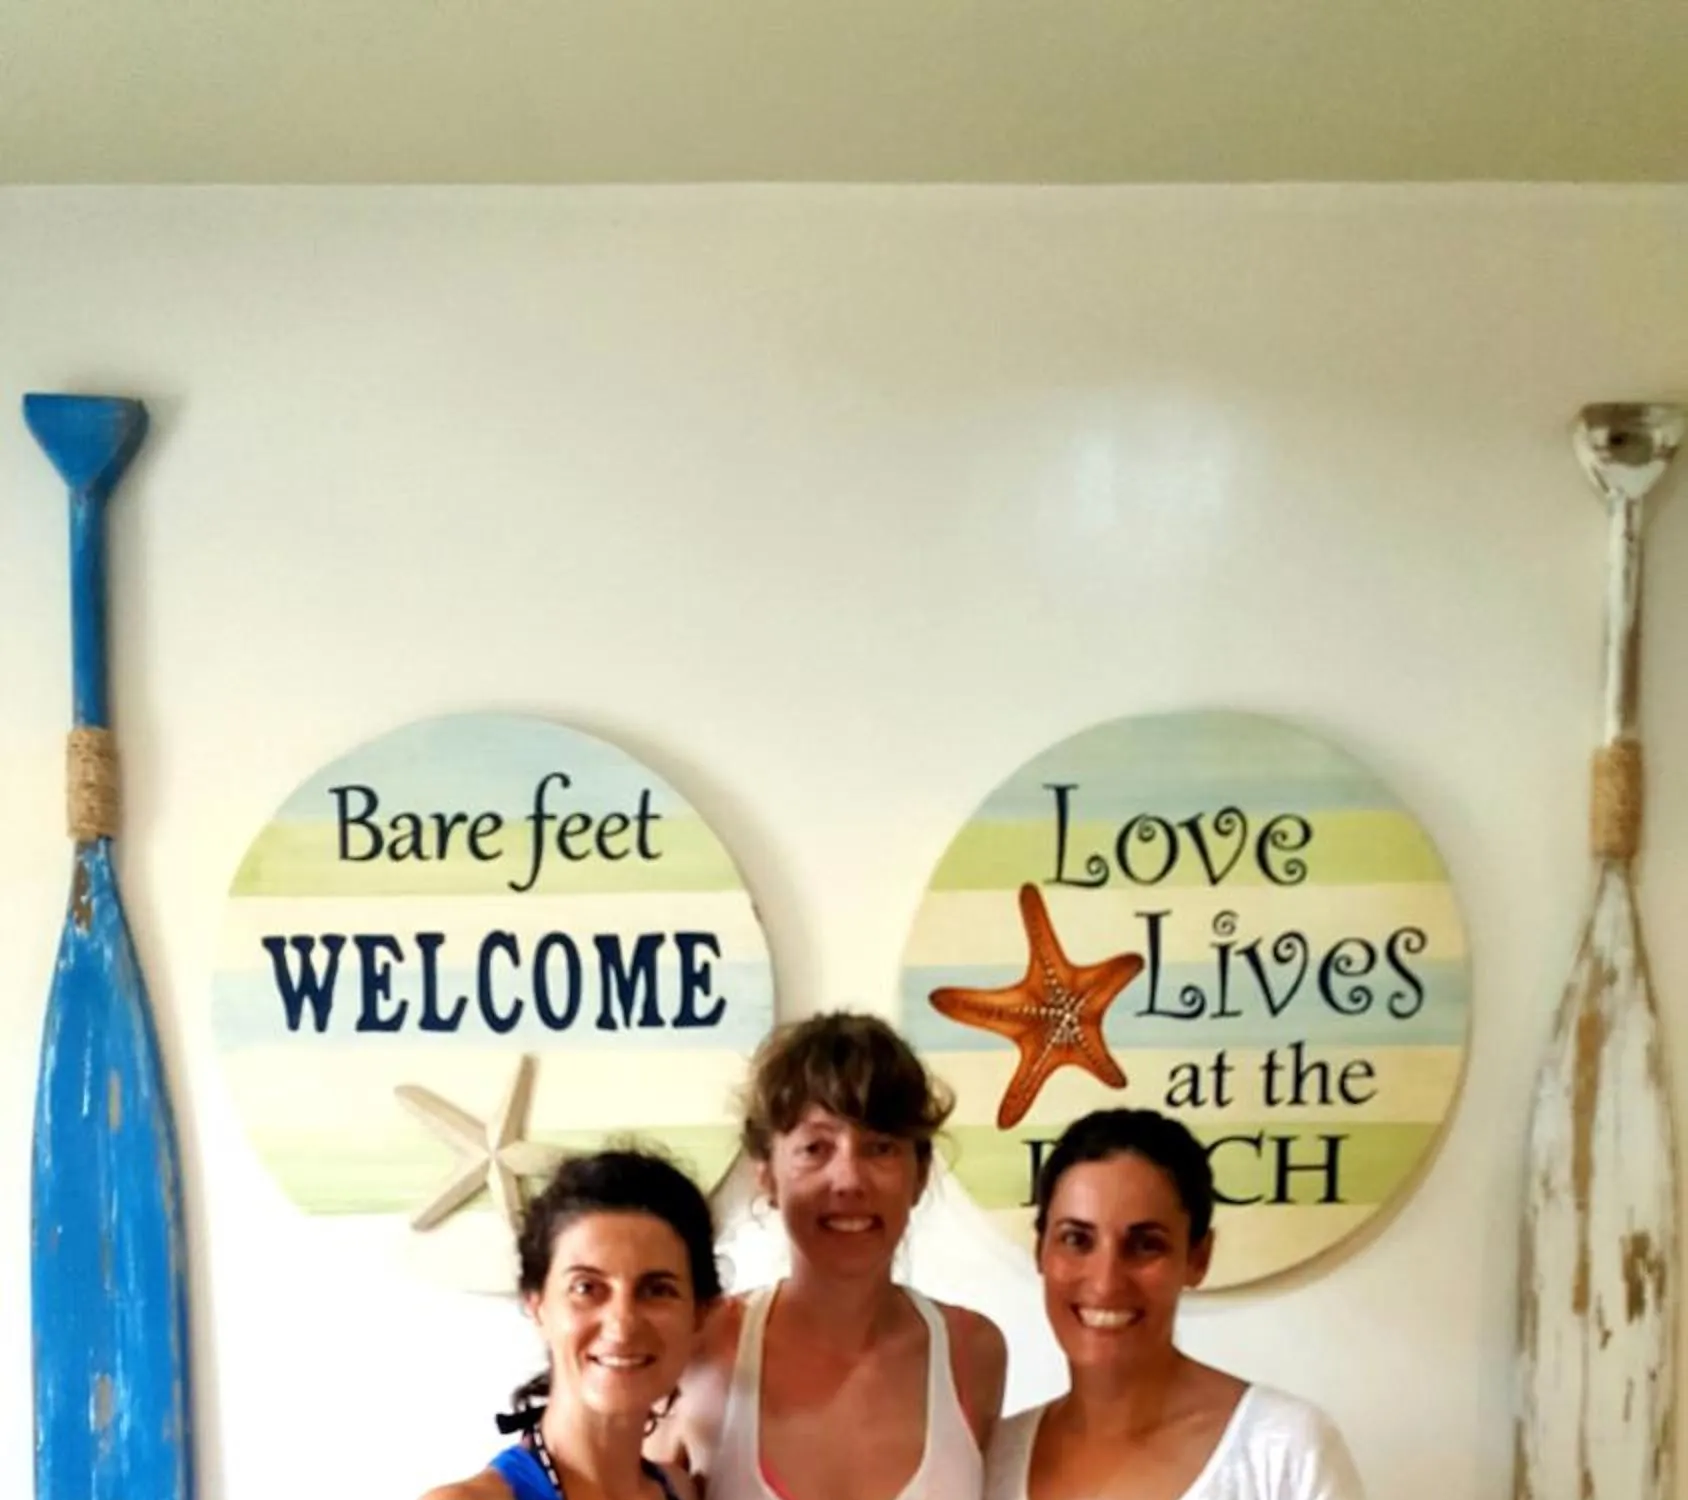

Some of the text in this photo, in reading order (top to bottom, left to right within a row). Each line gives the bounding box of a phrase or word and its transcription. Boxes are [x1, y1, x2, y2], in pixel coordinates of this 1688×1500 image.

[328, 772, 662, 893] Bare feet
[1042, 784, 1313, 889] Love
[262, 930, 727, 1034] WELCOME
[1134, 910, 1428, 1021] Lives
[1163, 1039, 1379, 1109] at the
